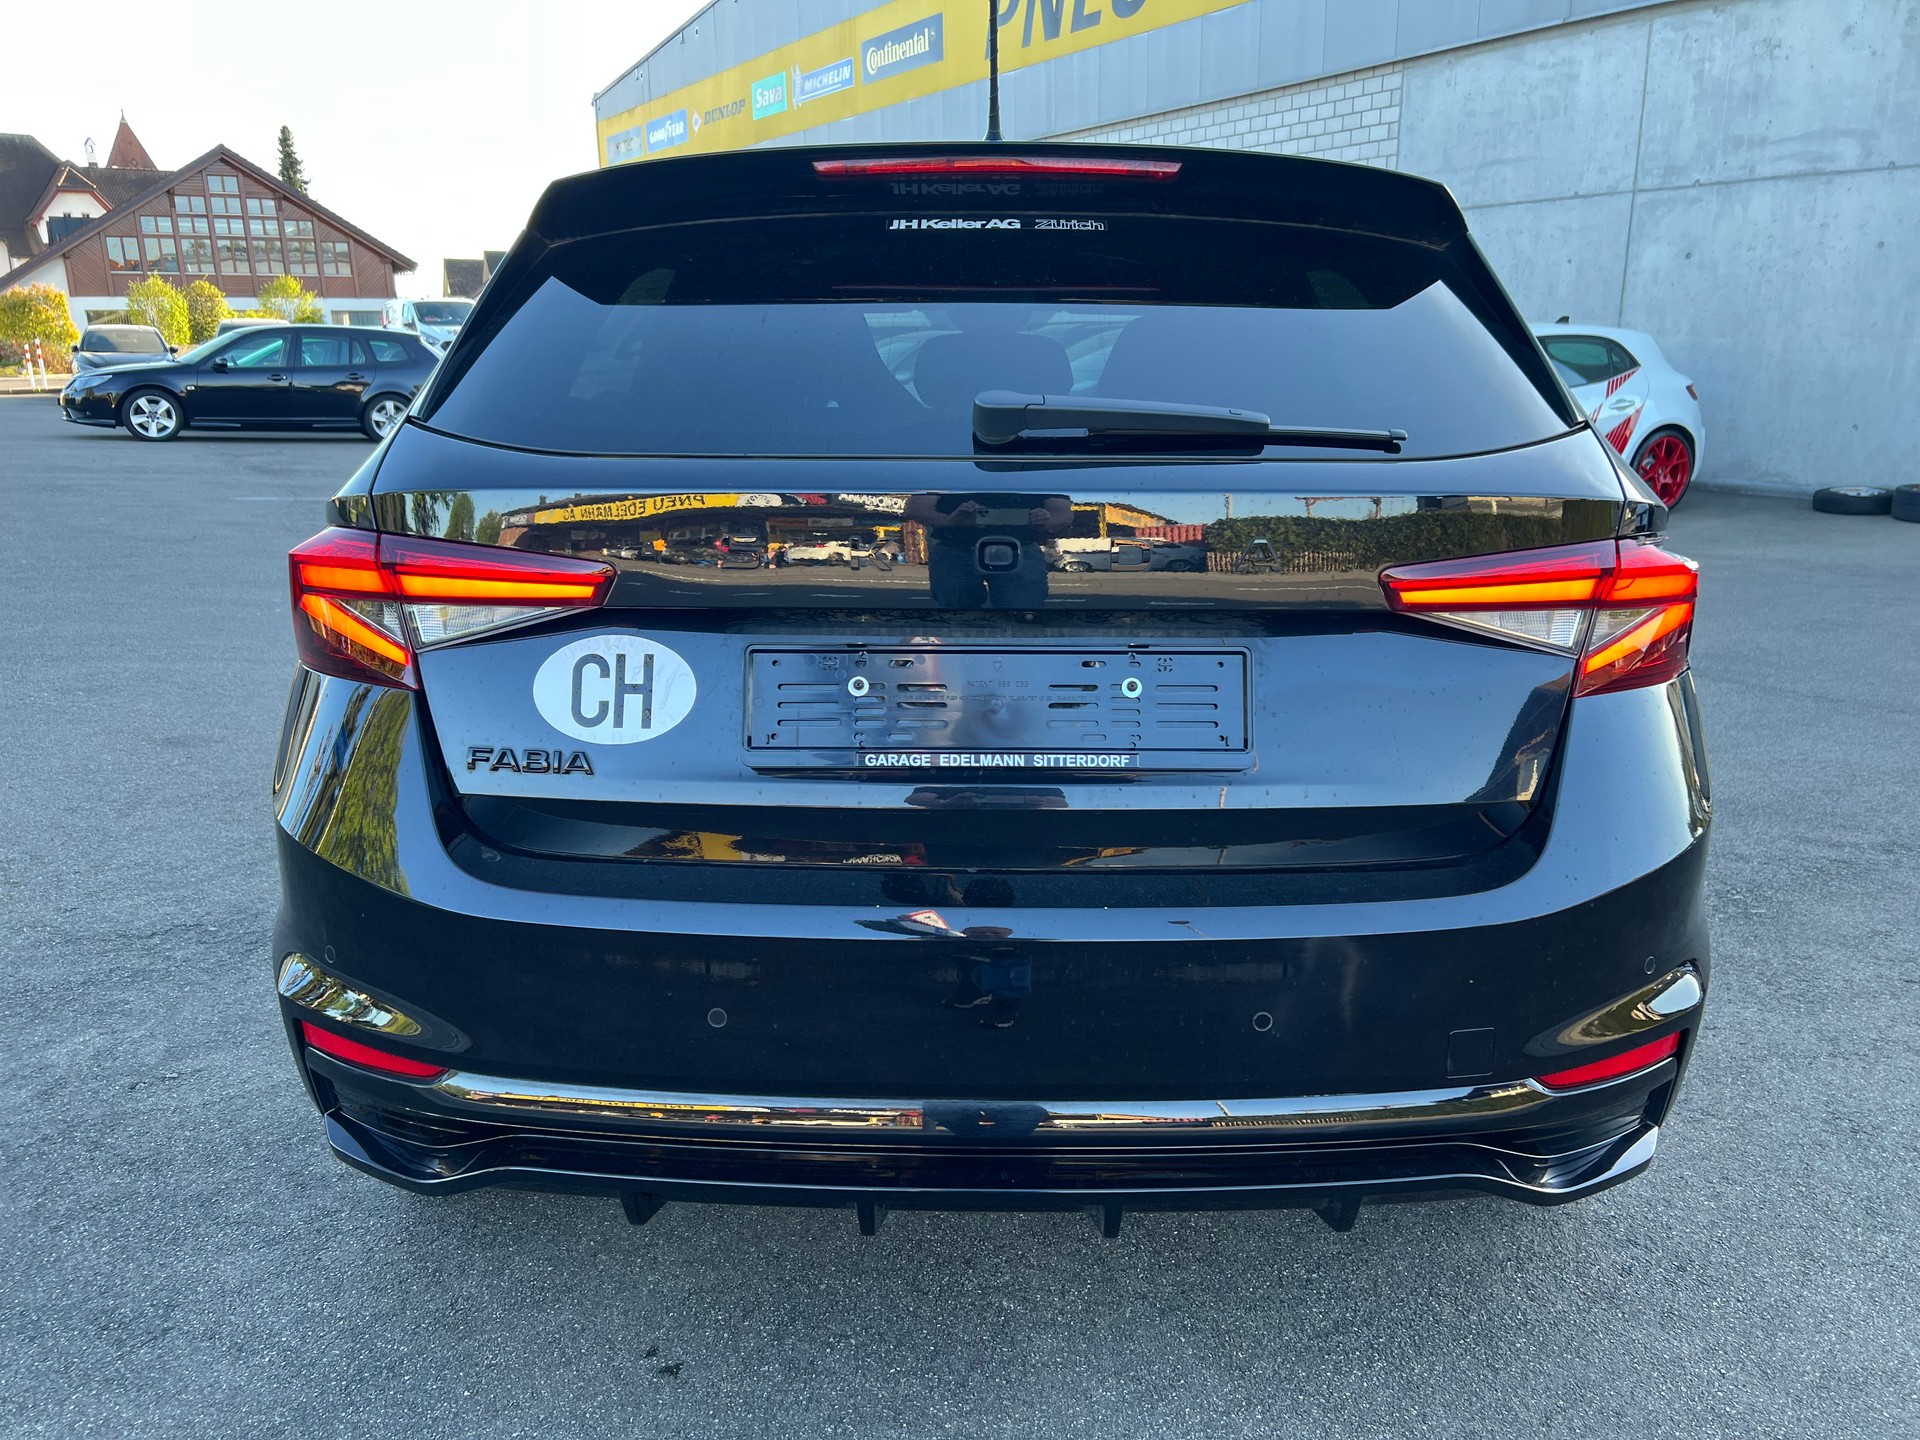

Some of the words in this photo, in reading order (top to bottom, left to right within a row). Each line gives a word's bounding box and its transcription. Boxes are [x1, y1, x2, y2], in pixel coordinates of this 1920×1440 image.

[866, 28, 930, 75] Continental
[804, 64, 851, 94] MICHELIN
[755, 84, 783, 110] Sava
[703, 99, 746, 125] DUNLOP
[1035, 218, 1105, 230] Zürich
[570, 652, 655, 729] CH
[467, 746, 594, 776] FABIA
[864, 753, 932, 767] GARAGE
[939, 754, 1025, 767] EDELMANN
[1032, 754, 1130, 768] SITTERDORF
